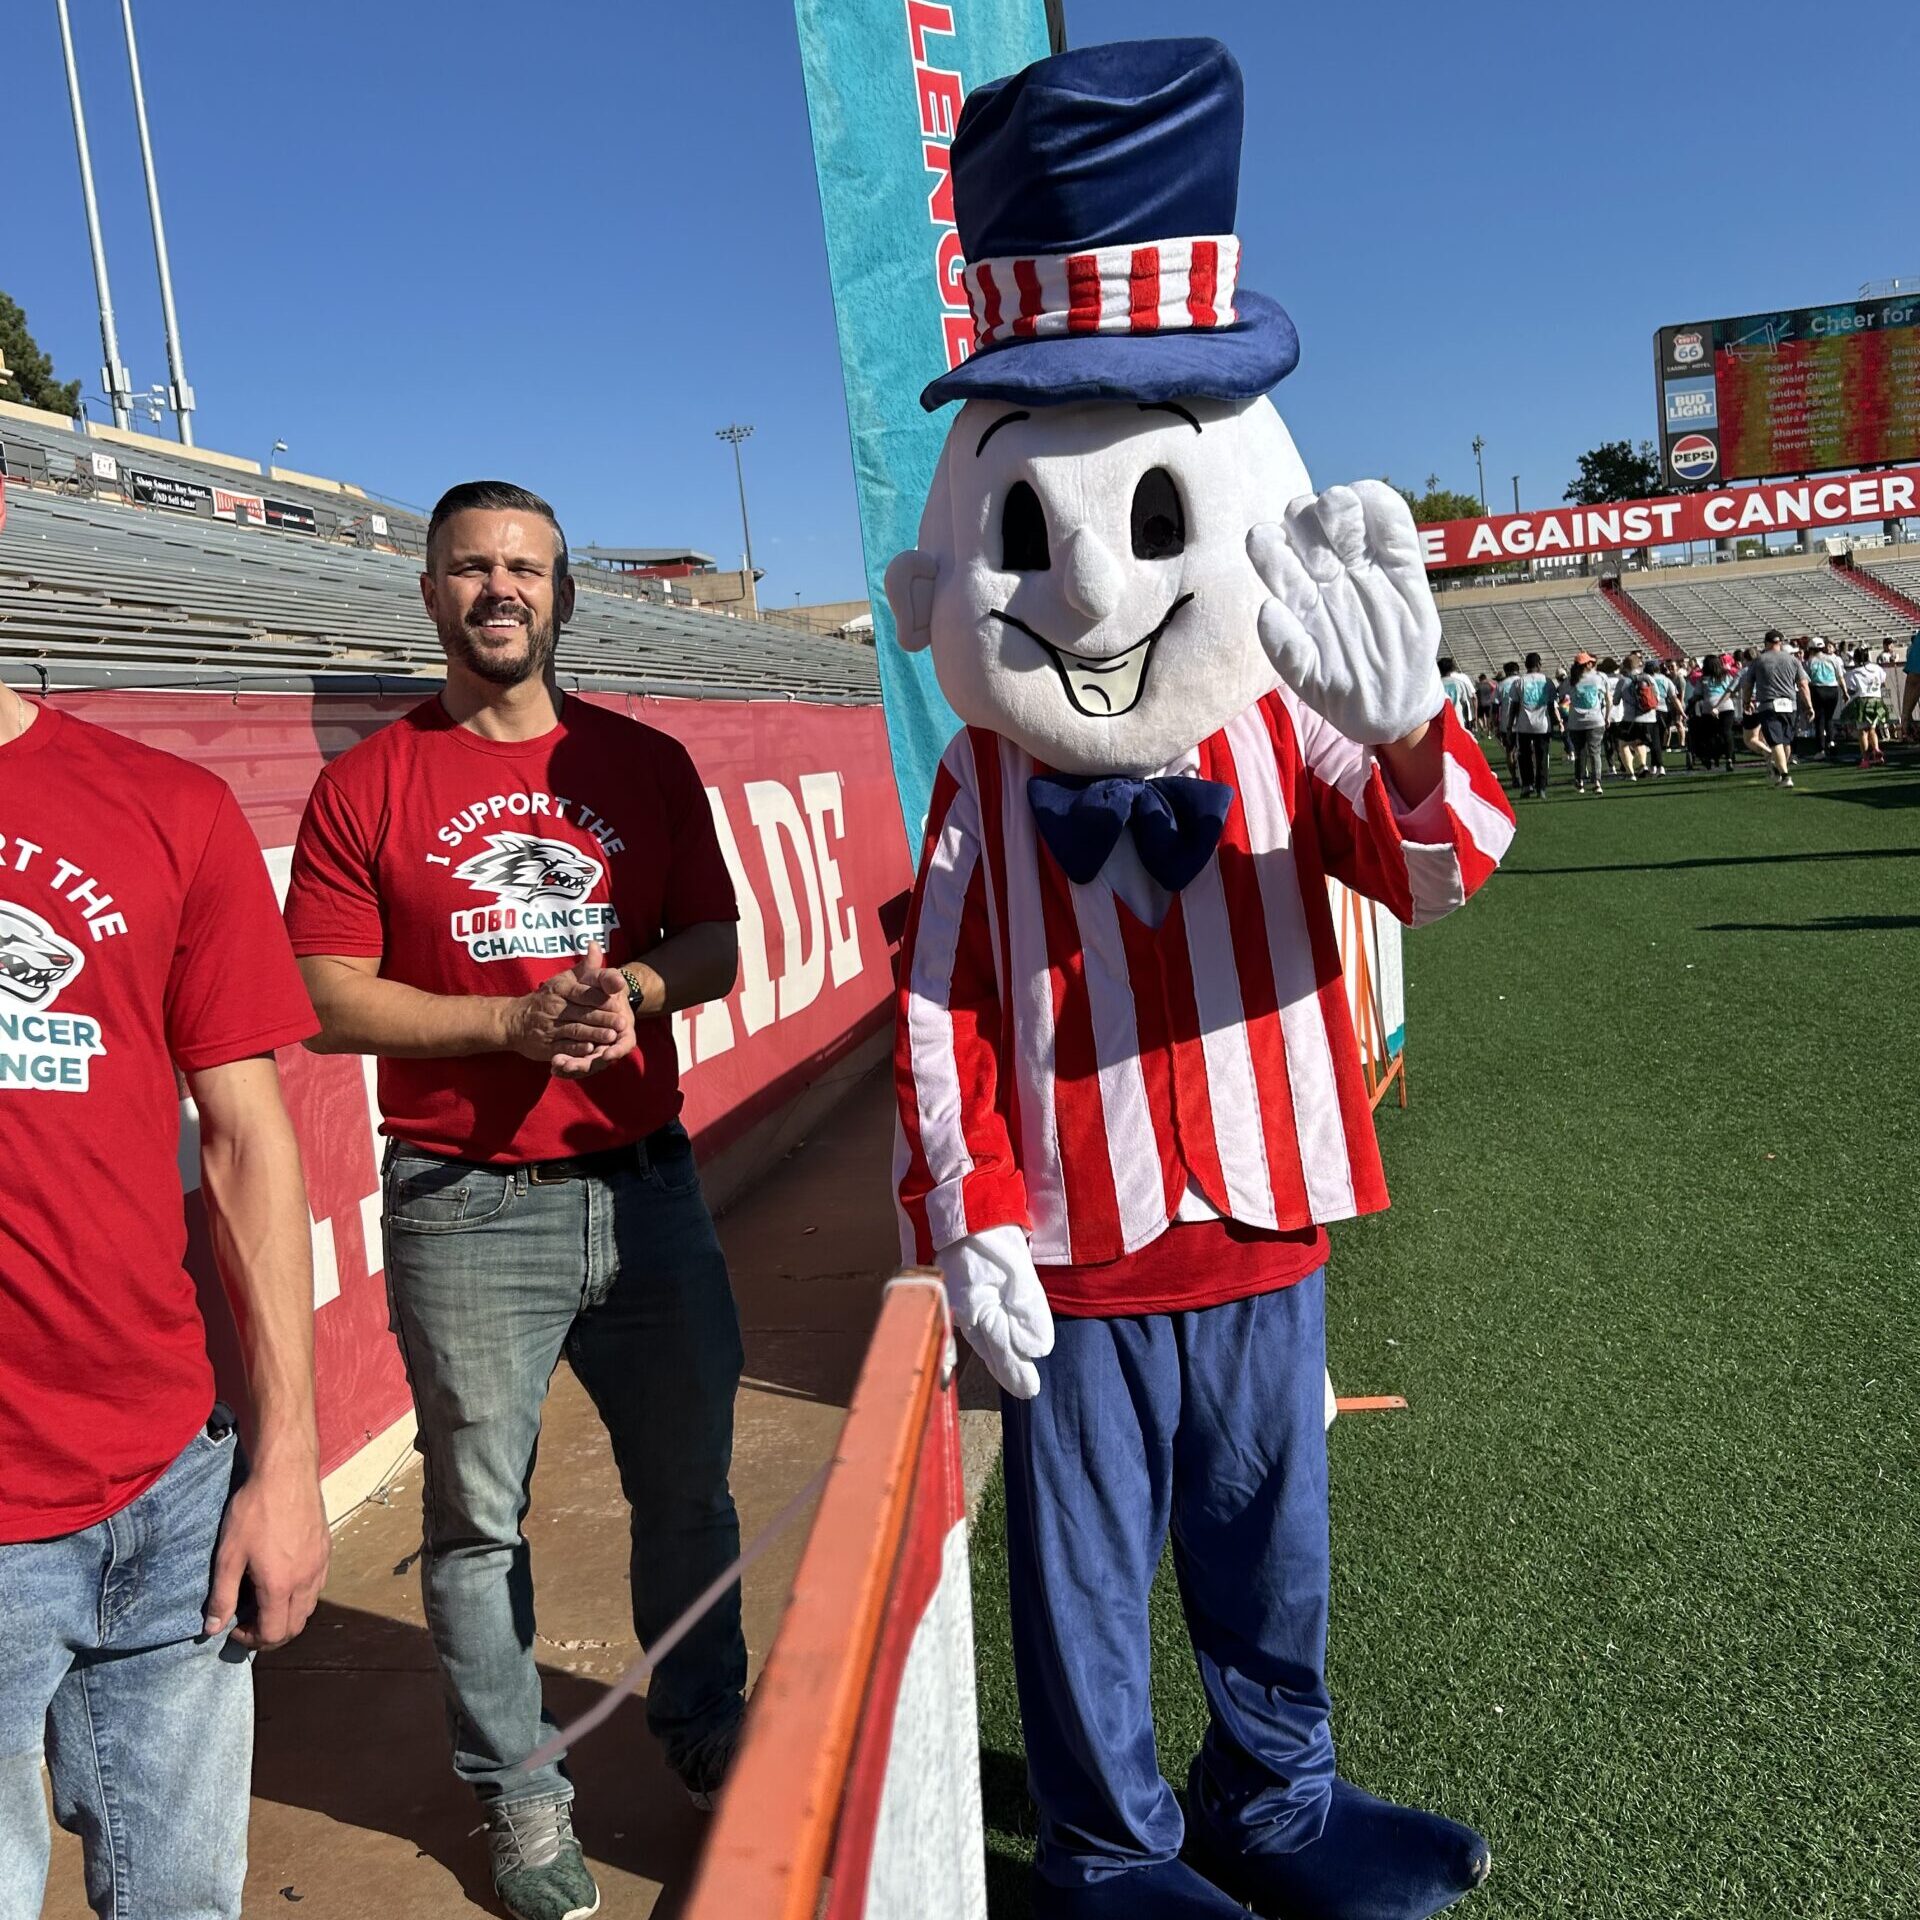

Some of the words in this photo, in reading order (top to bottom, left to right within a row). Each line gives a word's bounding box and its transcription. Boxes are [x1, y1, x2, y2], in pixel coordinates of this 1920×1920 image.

[1811, 312, 1876, 333] Cheer
[1882, 307, 1914, 325] for
[1679, 345, 1699, 359] 66
[1769, 374, 1804, 385] Ronald
[1675, 393, 1706, 407] BUD
[1669, 403, 1713, 418] LIGHT
[1773, 426, 1816, 438] Shannon
[1772, 440, 1807, 451] Sharon
[1674, 450, 1715, 464] PEPSI
[180, 497, 196, 509] Smar
[1467, 502, 1682, 560] AGAINST
[1703, 476, 1917, 532] CANCER
[438, 792, 571, 847] SUPPORT
[577, 804, 626, 857] THE
[426, 853, 451, 867] I
[50, 857, 129, 942] THE
[456, 908, 516, 938] LOBO
[522, 907, 617, 930] CANCER
[472, 932, 606, 958] CHALLENGE
